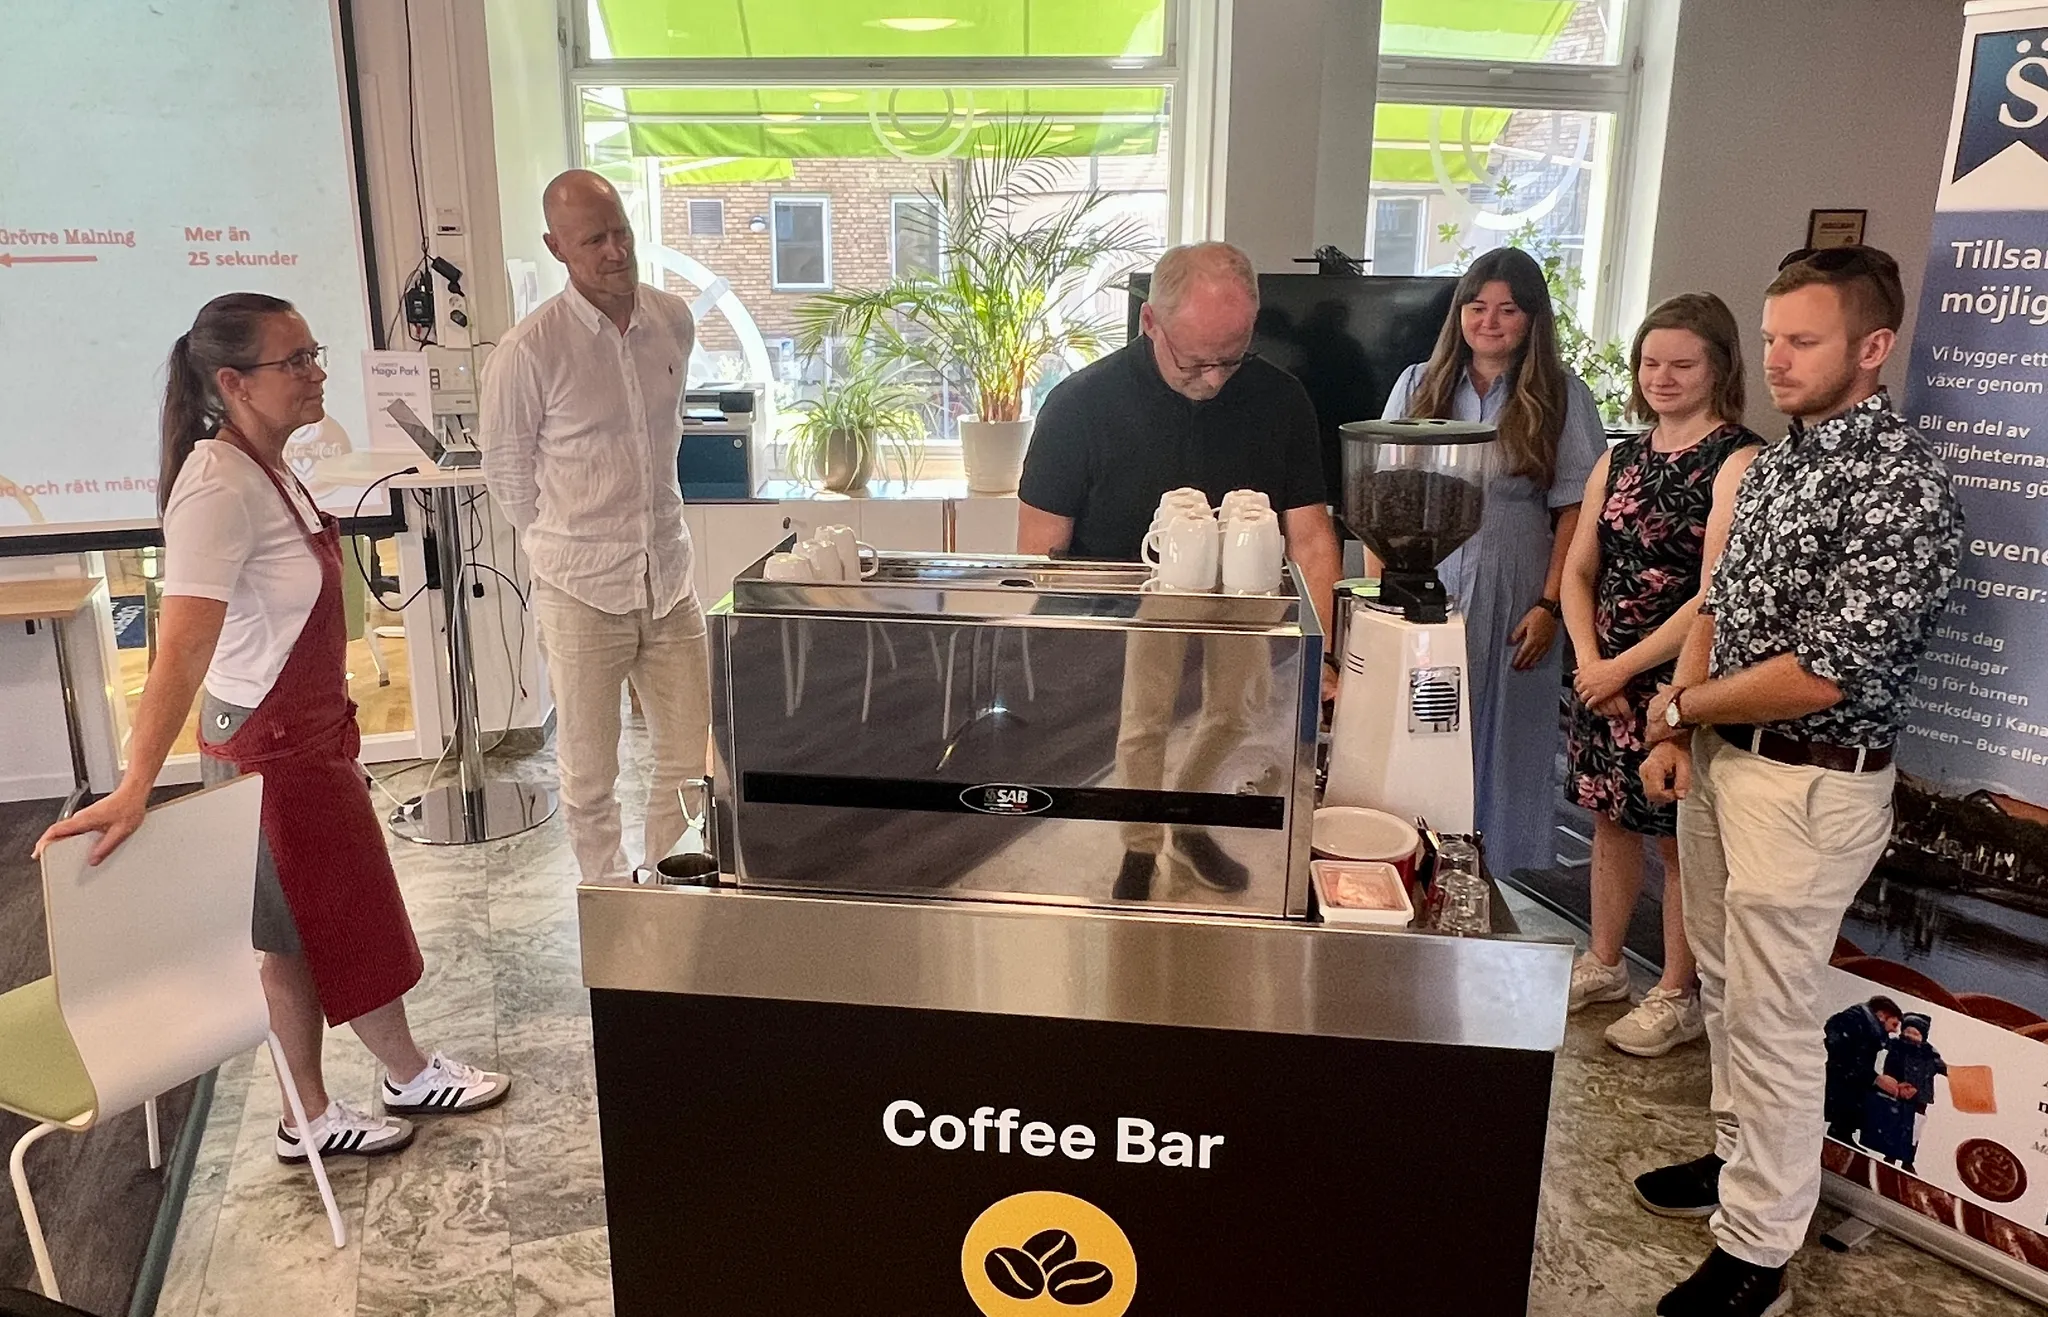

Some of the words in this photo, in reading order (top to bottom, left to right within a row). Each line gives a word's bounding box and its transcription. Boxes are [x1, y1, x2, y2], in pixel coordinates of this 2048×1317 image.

[63, 228, 136, 248] Malning
[184, 226, 223, 241] Mer
[228, 225, 251, 242] än
[188, 251, 210, 266] 25
[215, 250, 298, 267] sekunder
[1932, 345, 1949, 361] Vi
[1952, 346, 2018, 368] bygger
[2020, 352, 2048, 367] ett
[399, 365, 420, 376] Park
[1926, 372, 1975, 389] växer
[1977, 378, 2043, 395] genom
[1918, 415, 1943, 430] Bli
[1946, 420, 1969, 433] en
[1973, 419, 2003, 436] del
[2006, 425, 2031, 439] av
[23, 480, 60, 497] och
[65, 479, 101, 494] rätt
[1951, 474, 2022, 494] mmans
[1972, 631, 2005, 652] dag
[1942, 676, 1967, 693] för
[1969, 681, 2028, 707] barnen
[1996, 713, 2002, 727] i
[1906, 724, 1959, 745] oween
[1976, 737, 2008, 756] Bus
[883, 1100, 1096, 1160] Coffee
[1116, 1117, 1225, 1169] Bar
